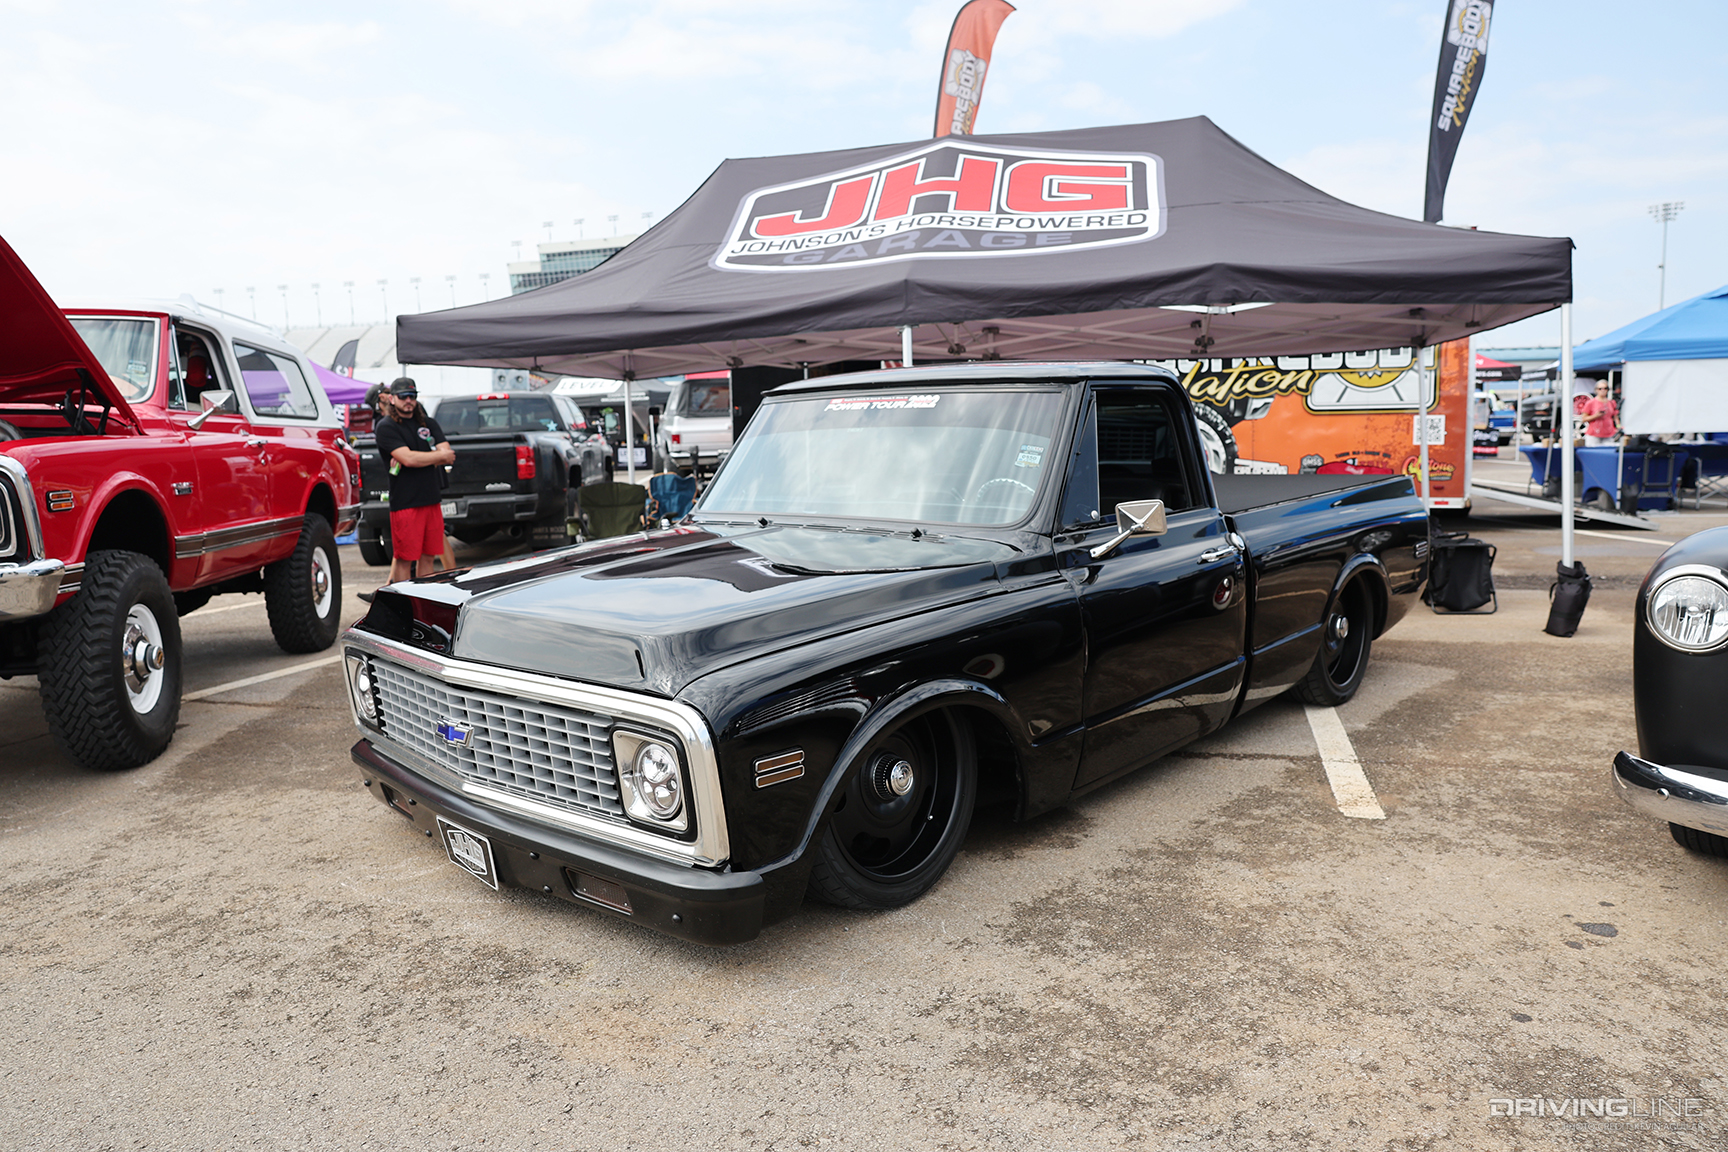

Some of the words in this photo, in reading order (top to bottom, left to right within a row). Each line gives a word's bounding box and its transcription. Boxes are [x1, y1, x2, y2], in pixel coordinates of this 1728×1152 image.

[950, 49, 979, 135] AREBODY
[751, 154, 1133, 237] JHG
[731, 223, 886, 255] JOHNSON'S
[896, 212, 1148, 231] HORSEPOWERED
[783, 229, 1074, 265] GARAGE
[824, 402, 870, 411] POWER
[870, 400, 904, 409] TOUR
